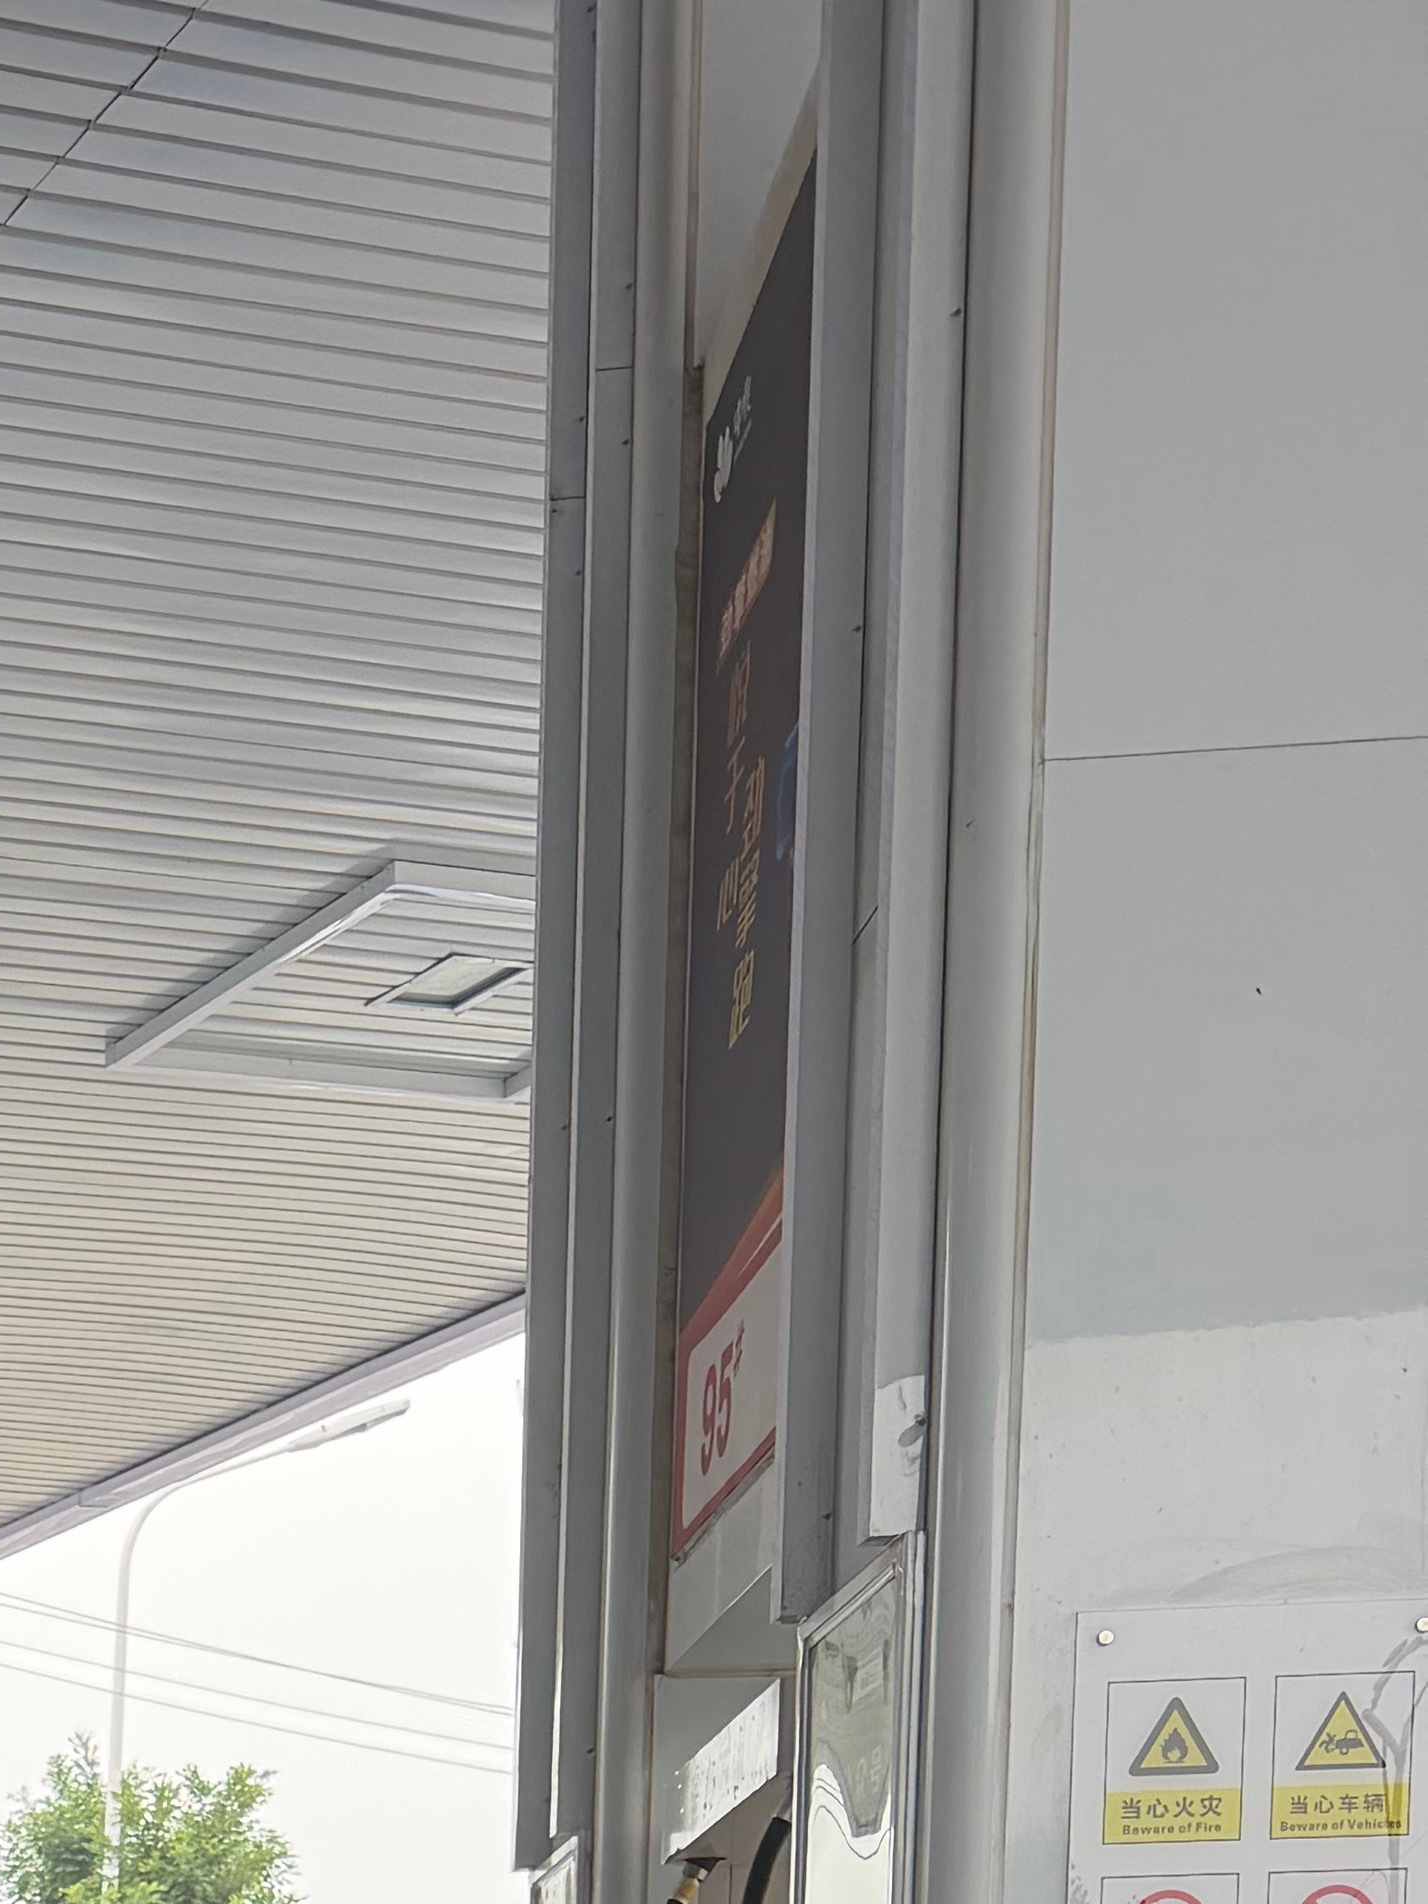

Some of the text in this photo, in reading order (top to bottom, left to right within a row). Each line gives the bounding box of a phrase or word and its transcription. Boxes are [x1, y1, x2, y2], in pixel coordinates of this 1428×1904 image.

[701, 1319, 745, 1476] 95#
[1121, 1794, 1223, 1820] 当心火灾
[1289, 1792, 1386, 1815] 当心车辆
[1122, 1821, 1222, 1836] Beware of Fire
[1279, 1821, 1329, 1832] Beware
[1331, 1819, 1345, 1831] of
